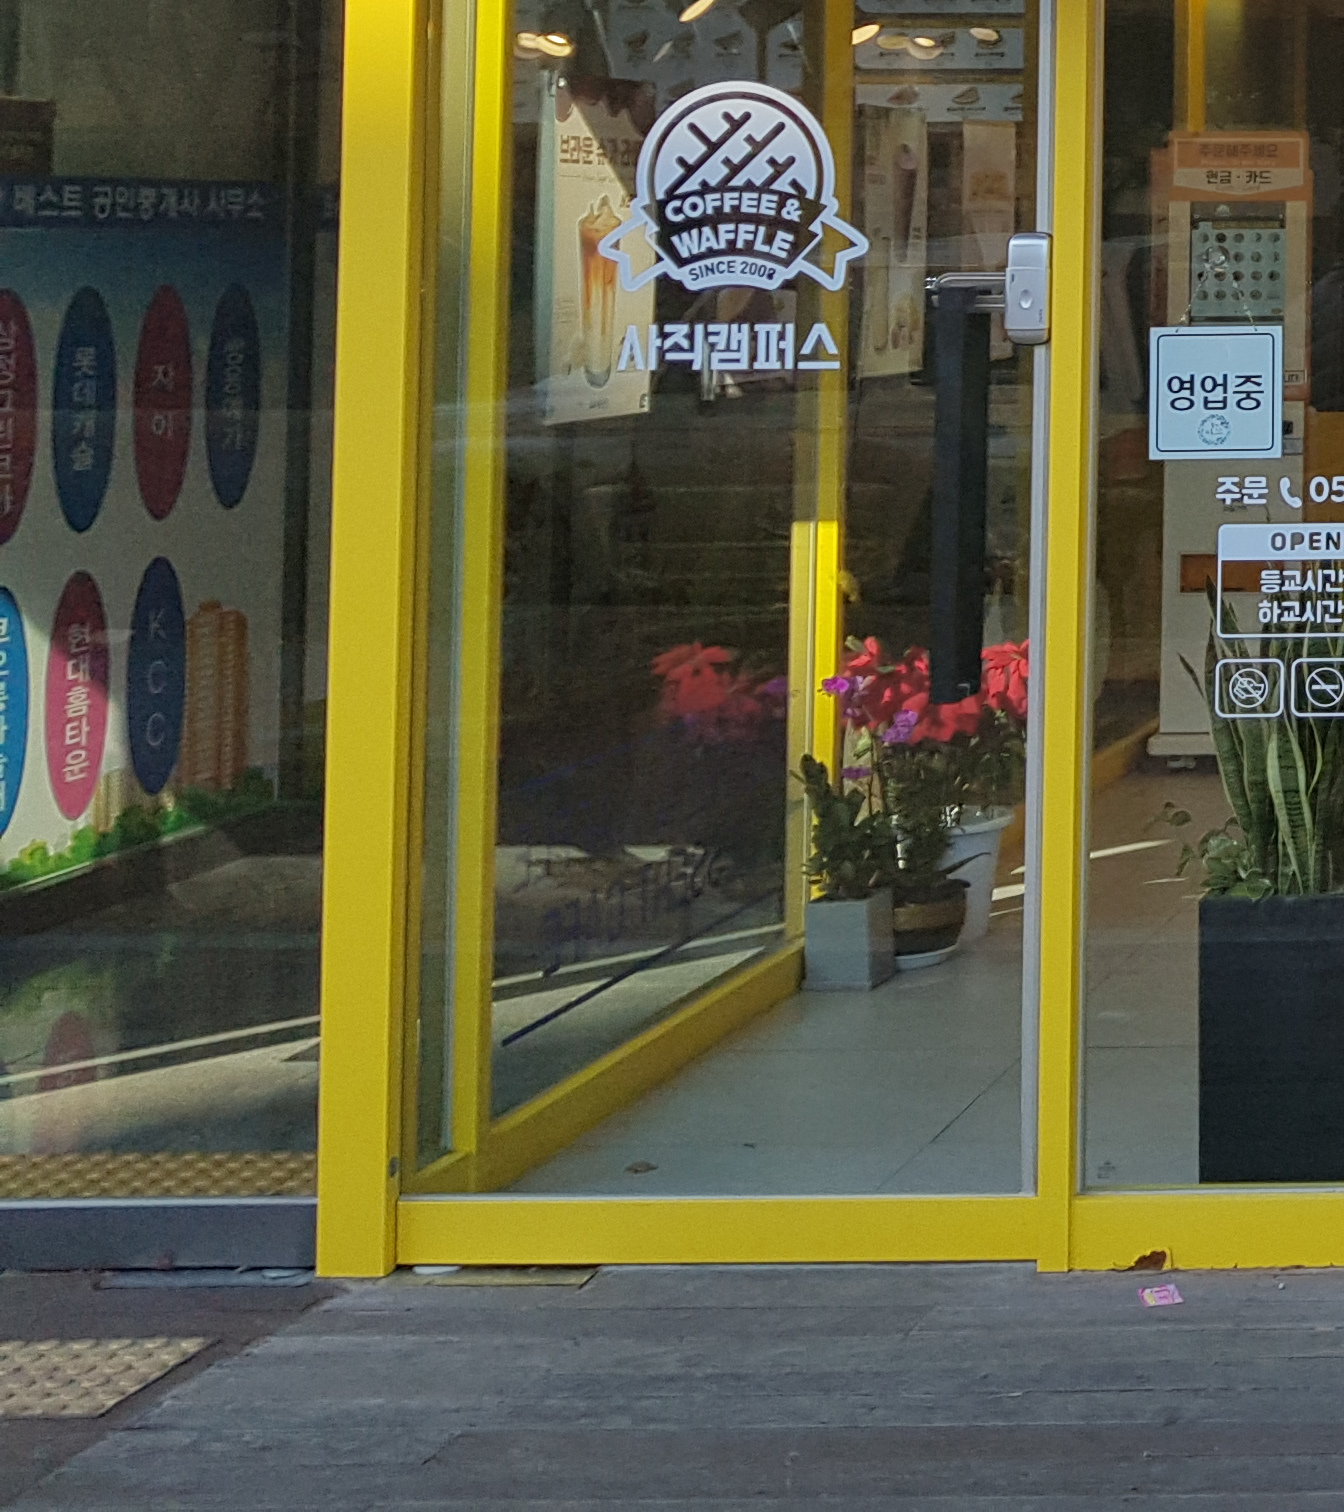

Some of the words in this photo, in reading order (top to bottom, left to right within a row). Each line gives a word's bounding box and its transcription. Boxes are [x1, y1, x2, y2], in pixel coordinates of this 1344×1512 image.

[1206, 170, 1232, 184] 현금
[1246, 170, 1272, 184] 카드
[665, 193, 777, 222] COFFEE
[781, 198, 802, 222] &
[670, 224, 794, 258] WAFFLE
[689, 260, 736, 282] SINCE
[740, 261, 776, 281] 2008
[616, 323, 841, 371] 사직캠퍼스
[1167, 373, 1265, 413] 영업중
[1215, 476, 1269, 506] 주문
[1270, 531, 1341, 551] OPEN
[1258, 599, 1344, 624] 하교시간
[62, 622, 91, 783] 현대홈타운
